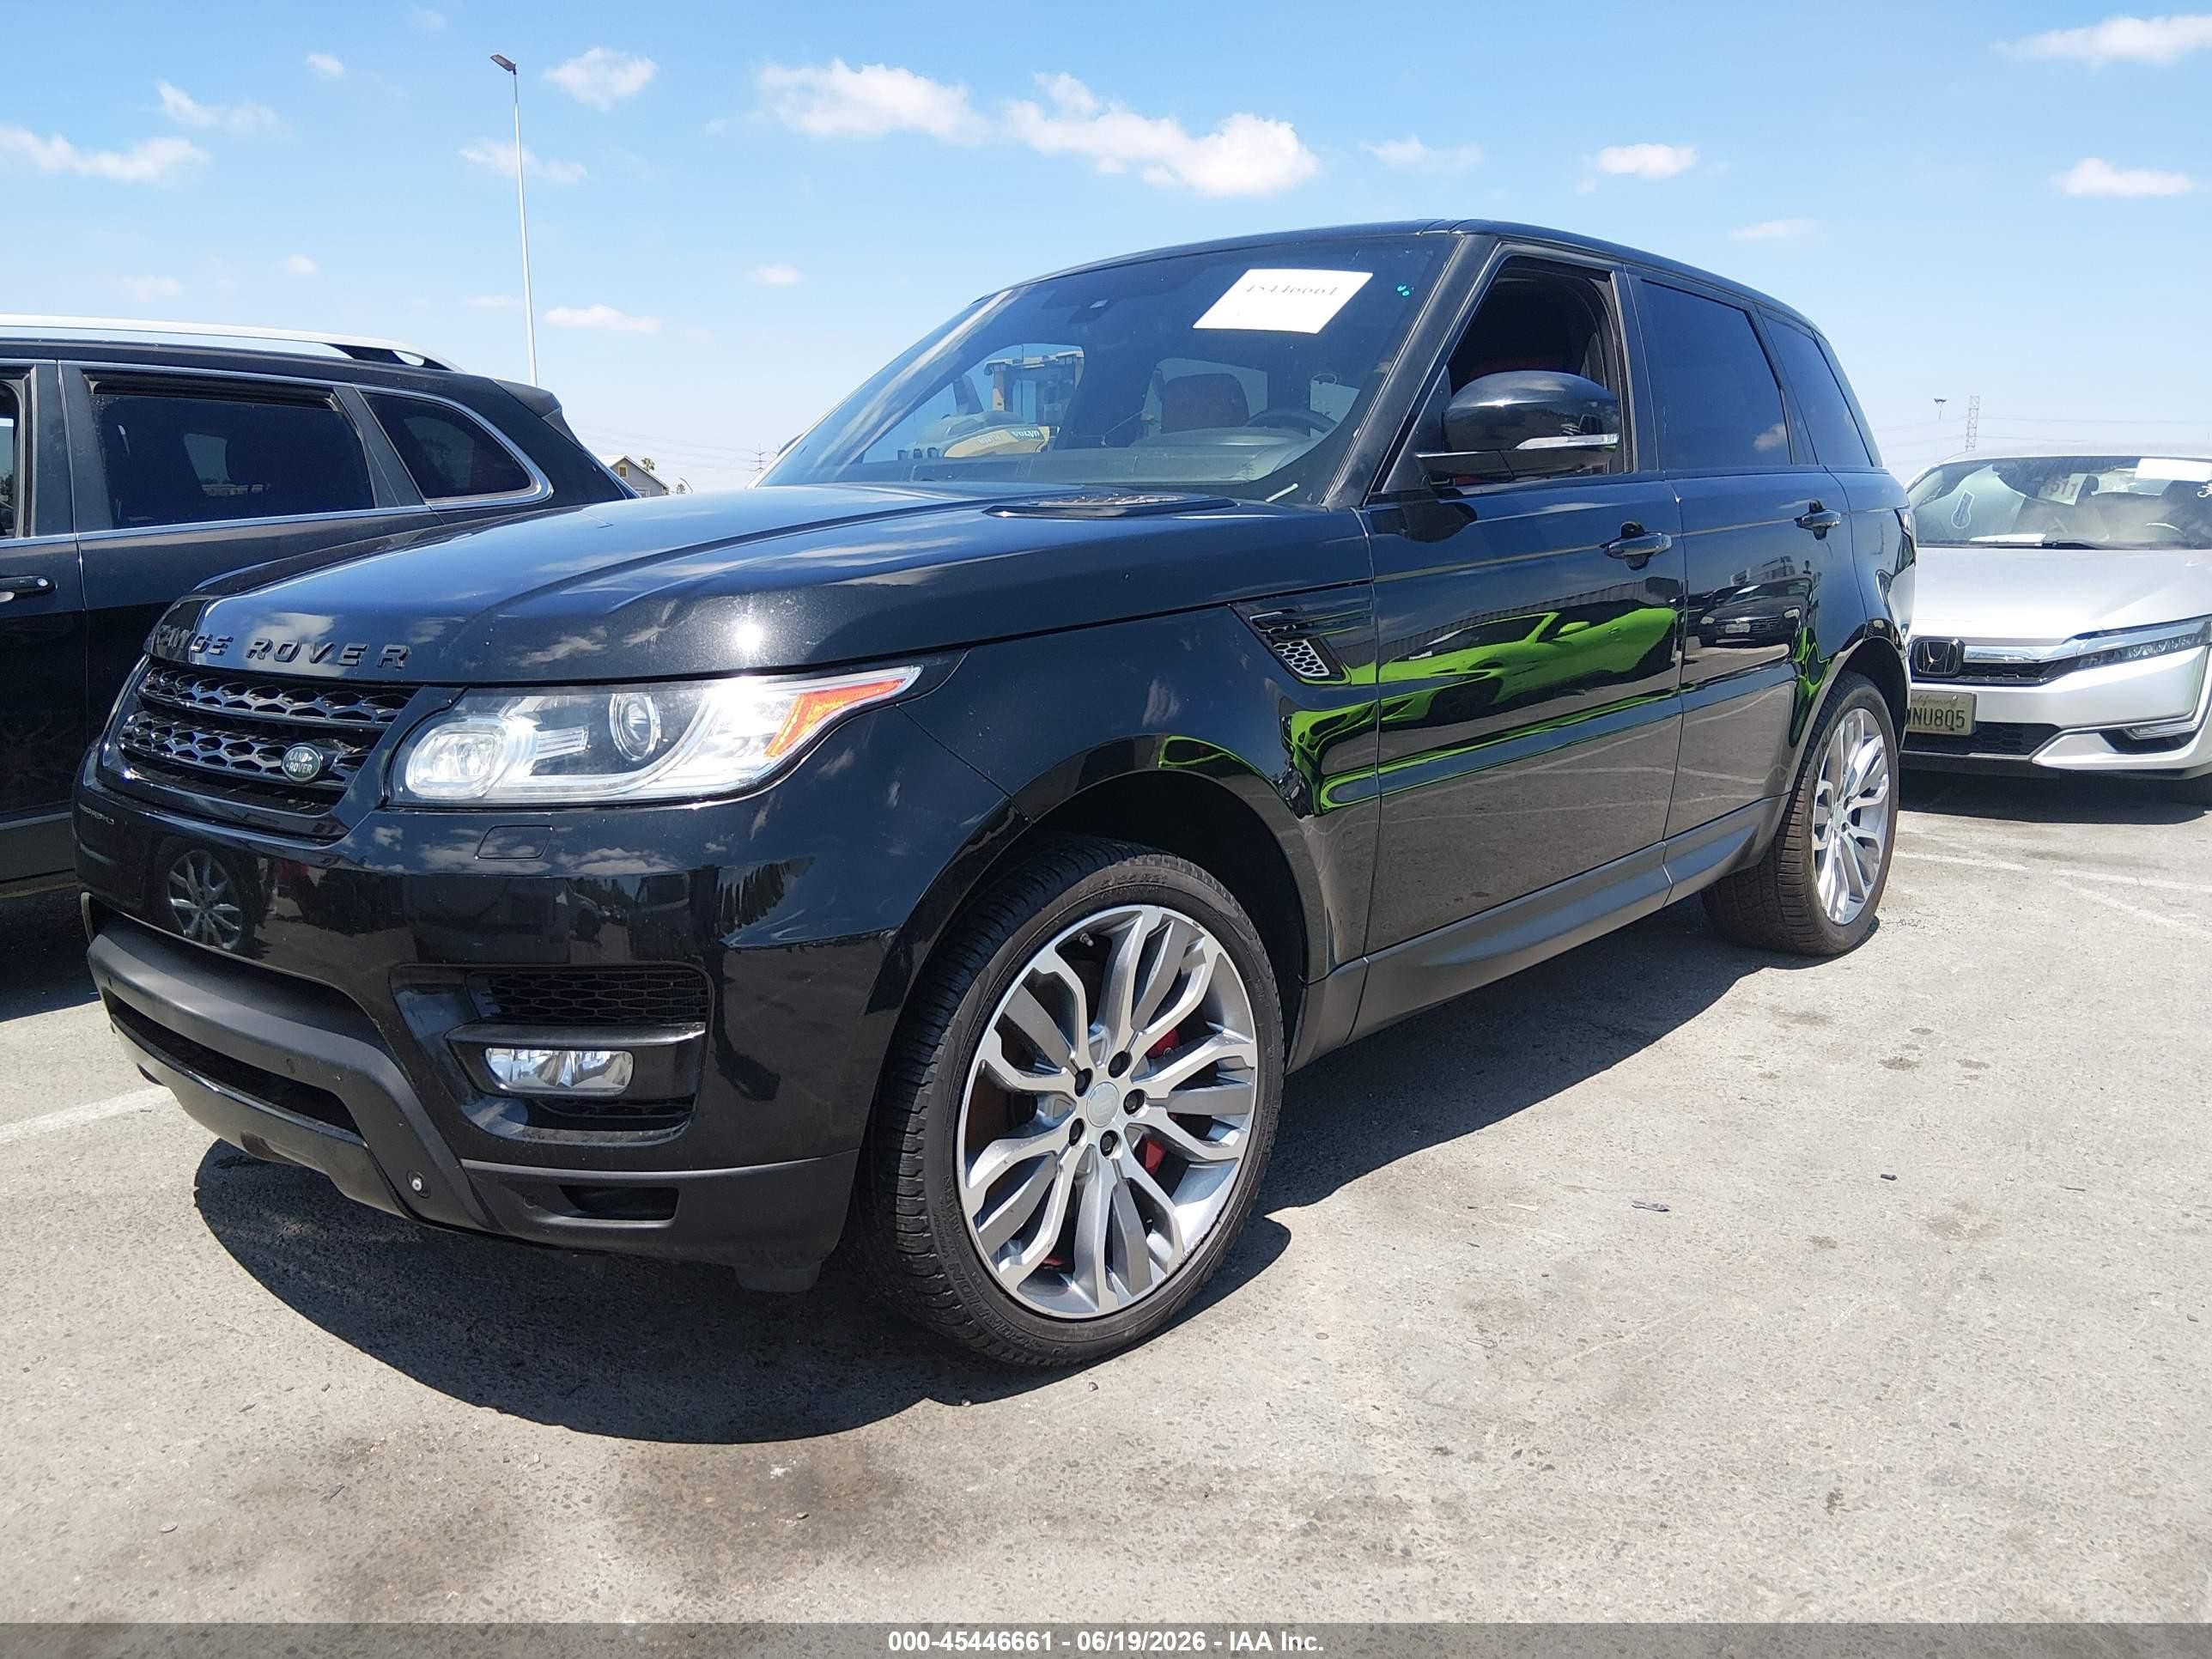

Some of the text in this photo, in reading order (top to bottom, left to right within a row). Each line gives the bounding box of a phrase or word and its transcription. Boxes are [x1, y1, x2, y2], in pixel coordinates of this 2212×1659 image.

[1011, 429, 1040, 438] VOLVO
[246, 638, 412, 670] ROVER
[289, 750, 309, 763] LAND
[289, 762, 313, 774] ROVER
